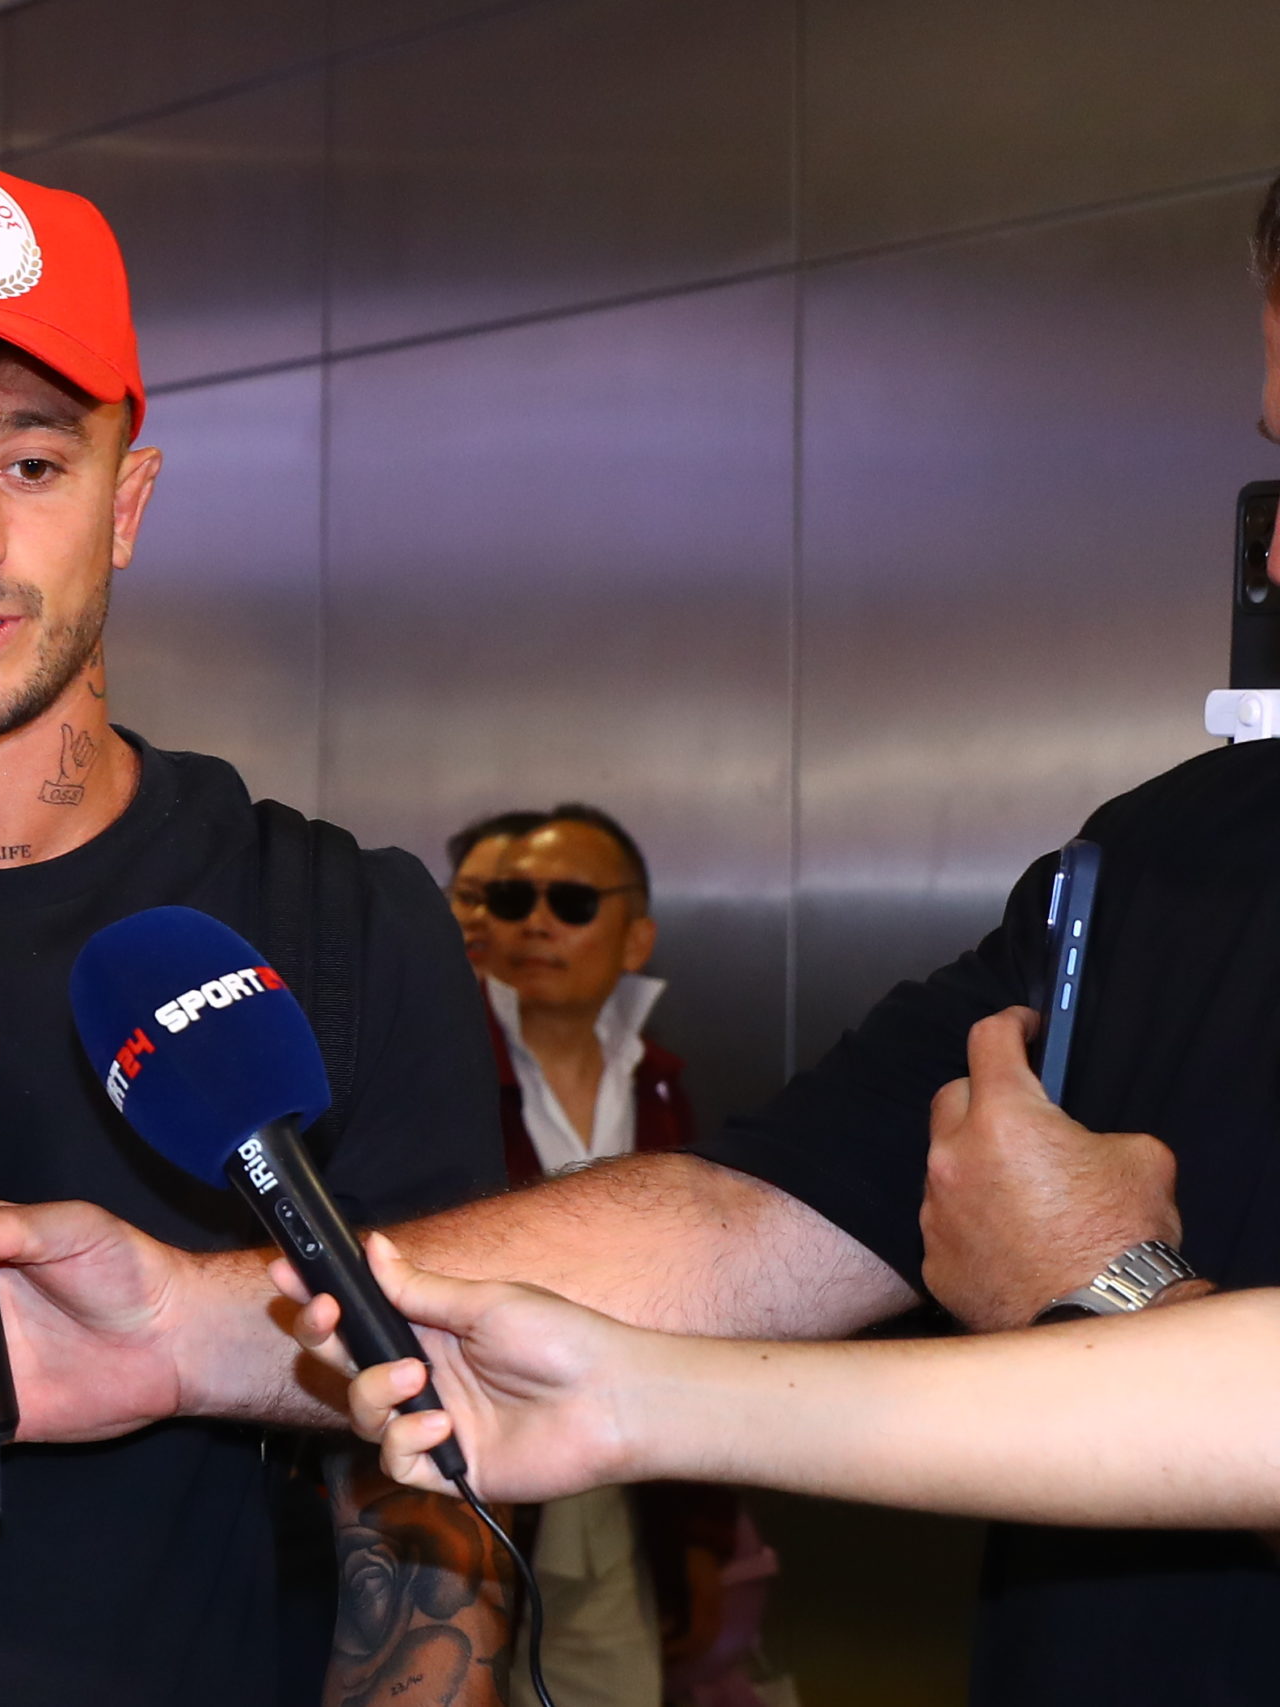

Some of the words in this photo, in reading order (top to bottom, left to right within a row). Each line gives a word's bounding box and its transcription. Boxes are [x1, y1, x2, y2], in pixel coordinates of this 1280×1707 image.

[154, 966, 288, 1033] SPORT2
[106, 1027, 156, 1113] RT24
[237, 1138, 279, 1195] iRig
